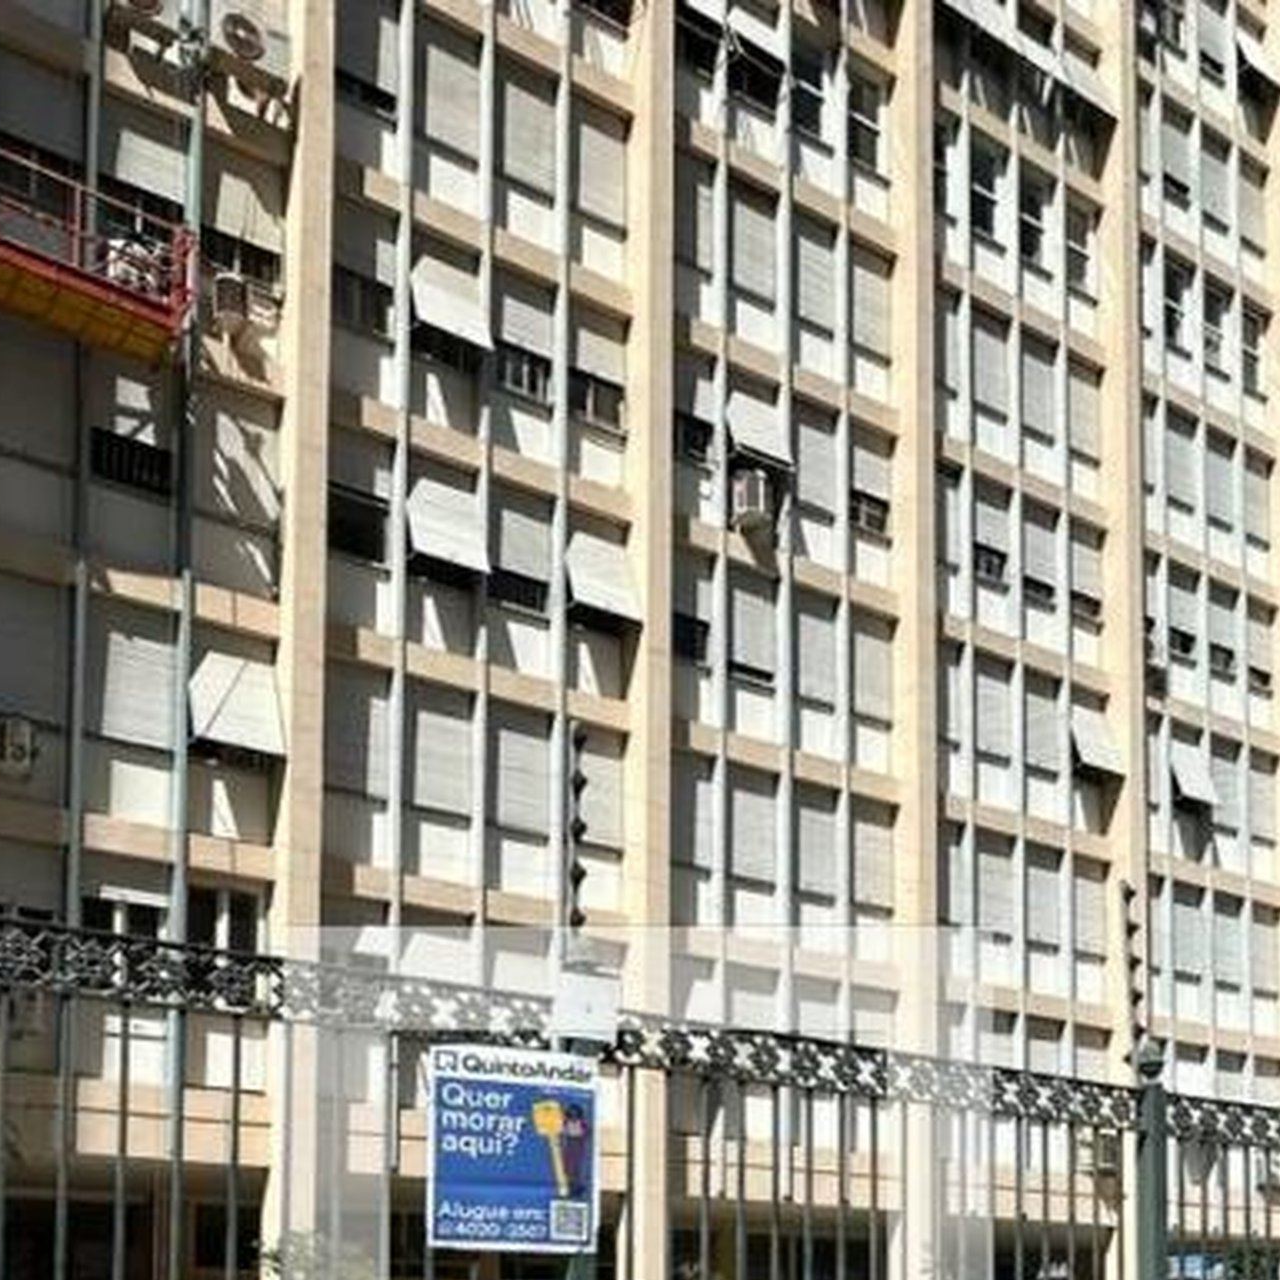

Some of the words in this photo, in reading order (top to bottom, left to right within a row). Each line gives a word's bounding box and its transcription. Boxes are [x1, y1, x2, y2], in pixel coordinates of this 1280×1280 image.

[441, 1082, 512, 1109] Quer
[441, 1110, 526, 1134] morar
[441, 1133, 520, 1158] aqui?
[438, 1200, 509, 1221] Alugue
